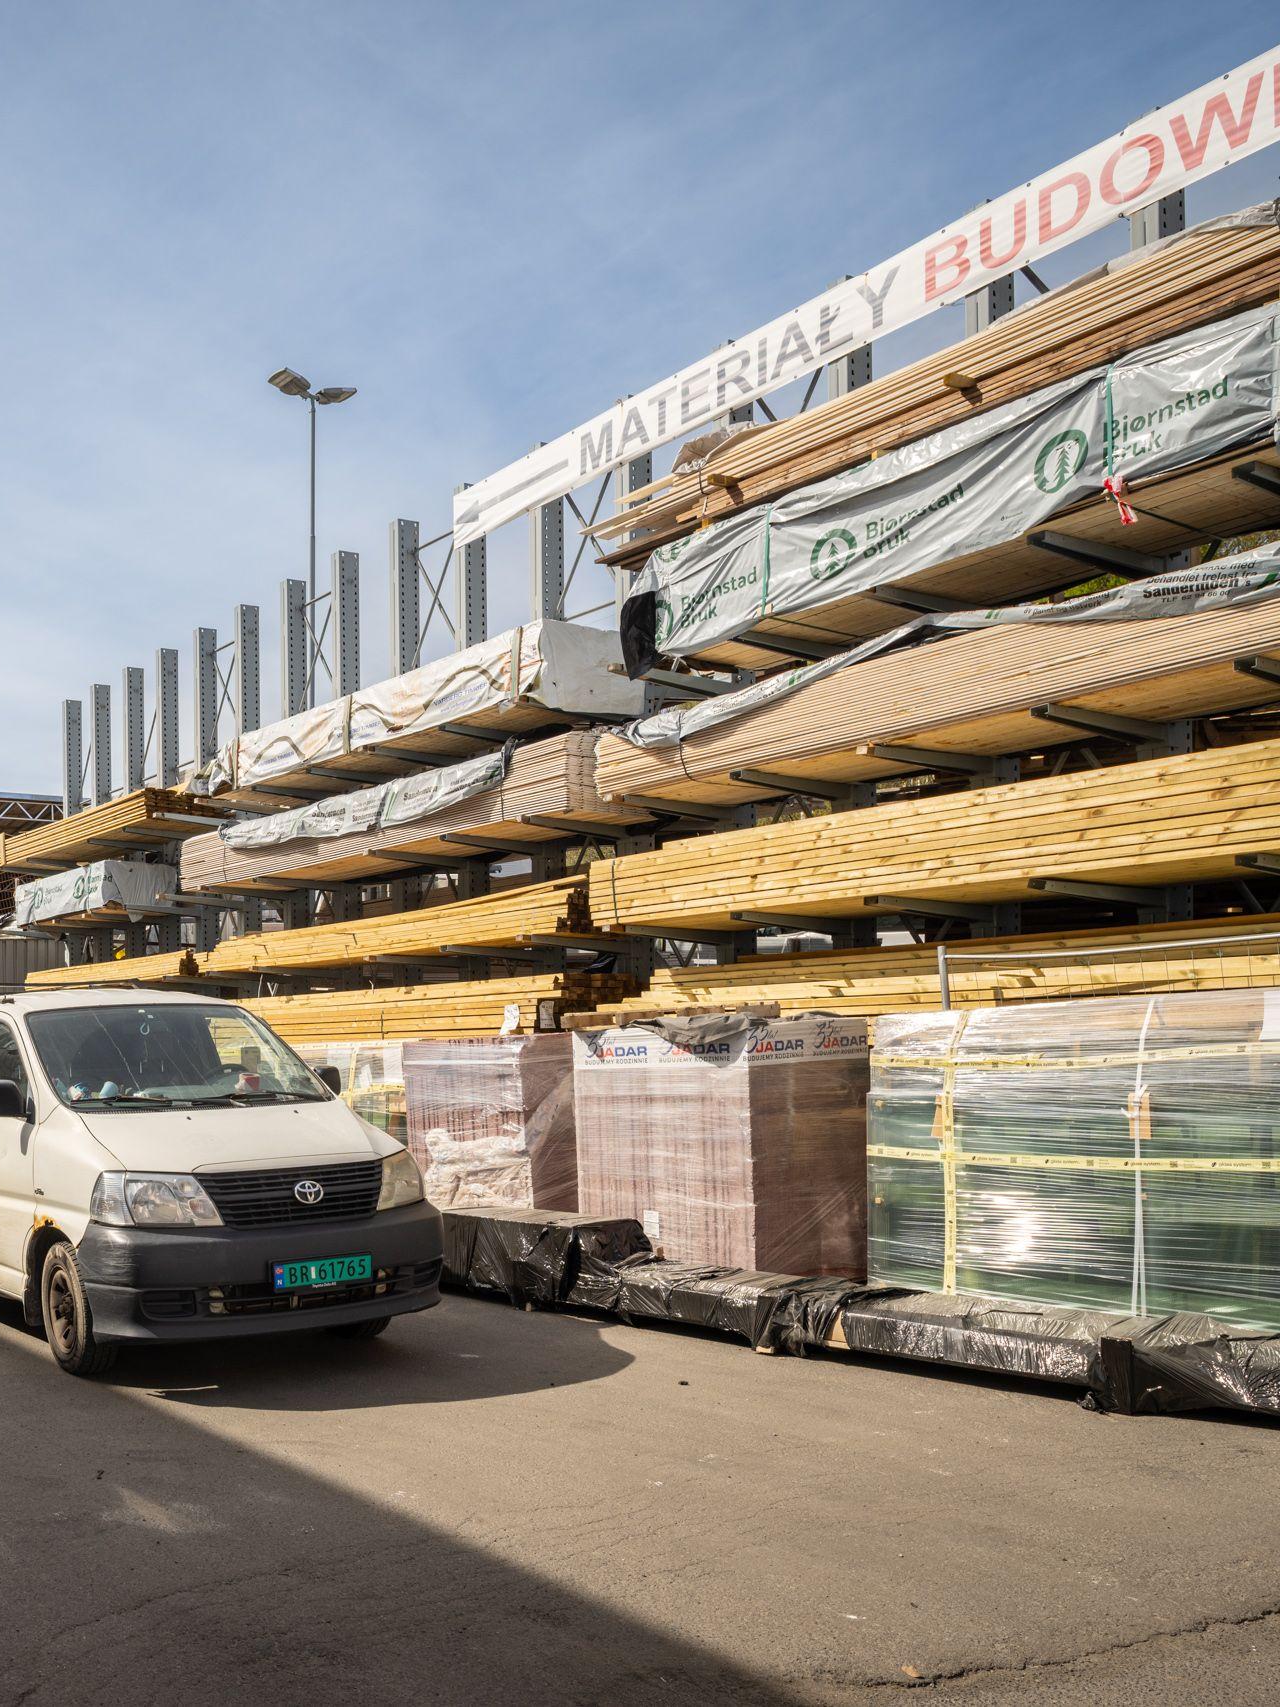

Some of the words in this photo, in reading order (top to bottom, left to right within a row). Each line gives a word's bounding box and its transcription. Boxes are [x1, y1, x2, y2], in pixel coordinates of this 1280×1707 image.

[579, 265, 901, 477] MATERIAŁY
[923, 62, 1280, 303] BUDOW
[1103, 375, 1228, 442] Bjørnstad
[755, 1039, 804, 1053] JADAR
[822, 1035, 867, 1049] JADAR
[596, 1045, 648, 1058] JADAR
[742, 1054, 773, 1062] BUDUJEMY
[616, 1057, 648, 1065] RODZINNIE
[288, 1266, 309, 1285] BR
[318, 1258, 367, 1281] 61765
